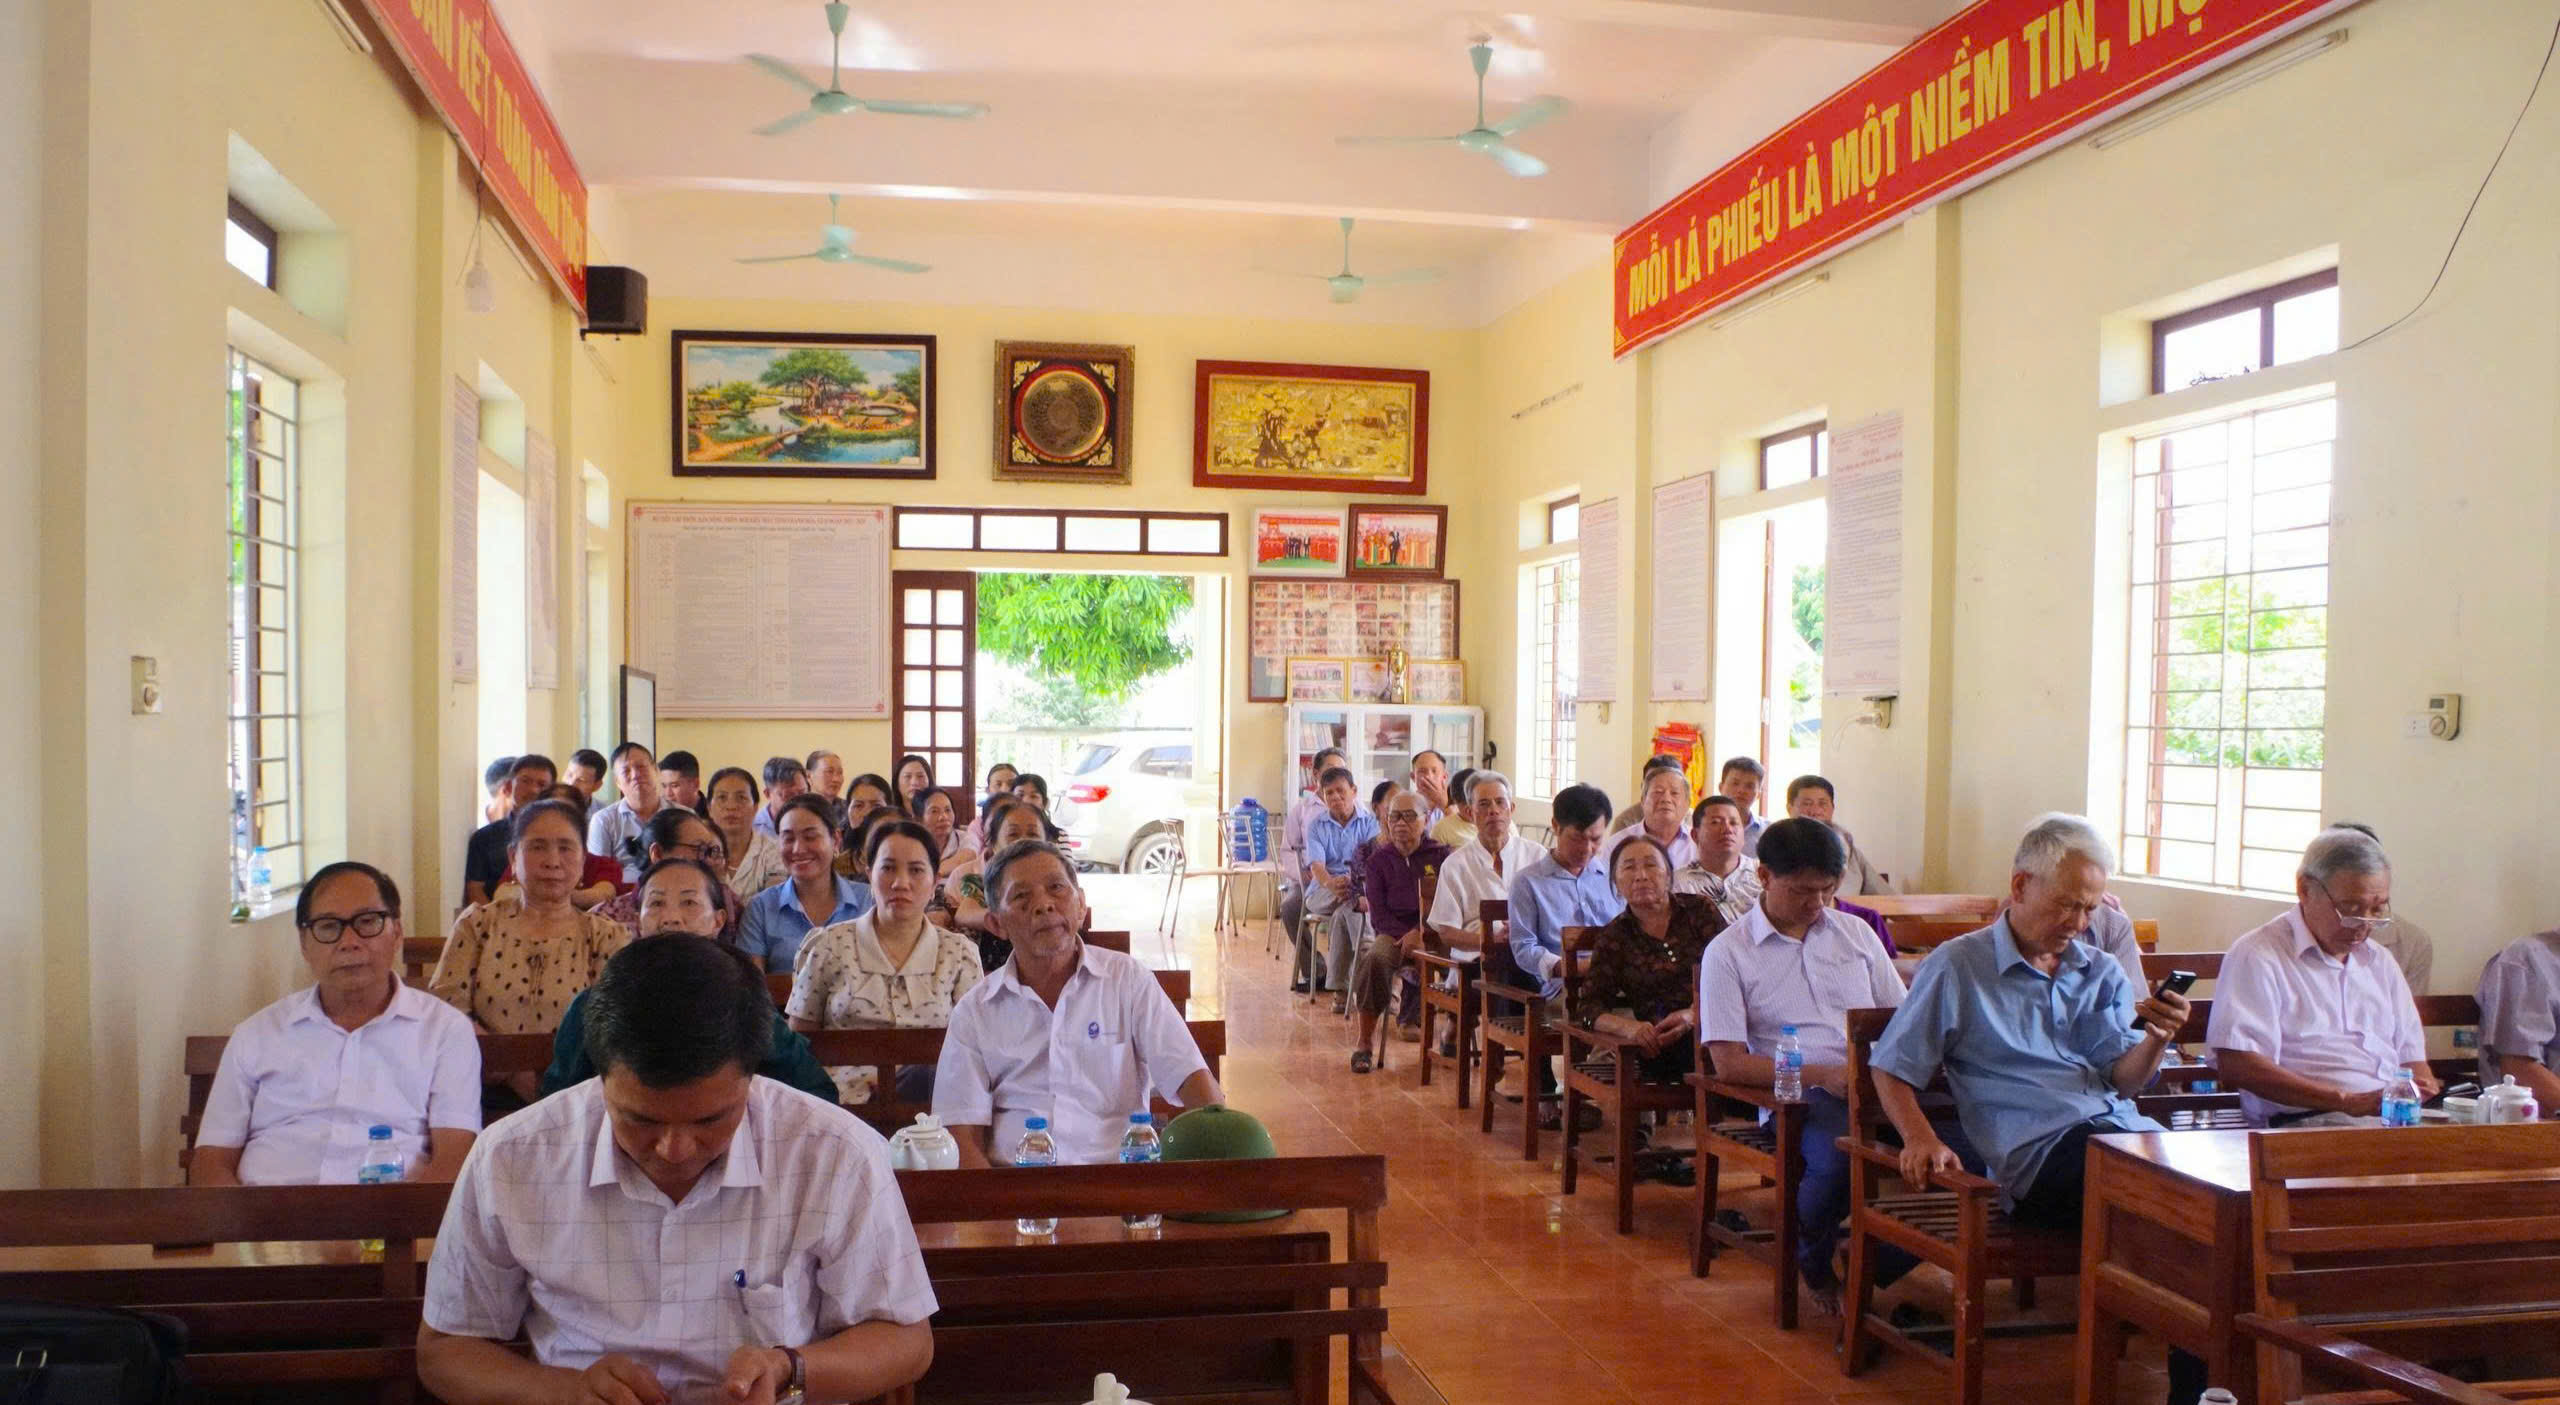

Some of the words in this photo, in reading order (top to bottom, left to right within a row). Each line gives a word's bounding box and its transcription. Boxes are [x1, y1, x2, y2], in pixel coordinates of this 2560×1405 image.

[1629, 232, 1668, 319] MỖI
[1674, 215, 1701, 294] LÁ
[1707, 166, 1780, 276] PHIẾU
[1788, 142, 1823, 230] LÀ
[1831, 103, 1900, 207] MỘT
[1911, 35, 2010, 163] NIỀM
[2023, 0, 2110, 100] TIN,
